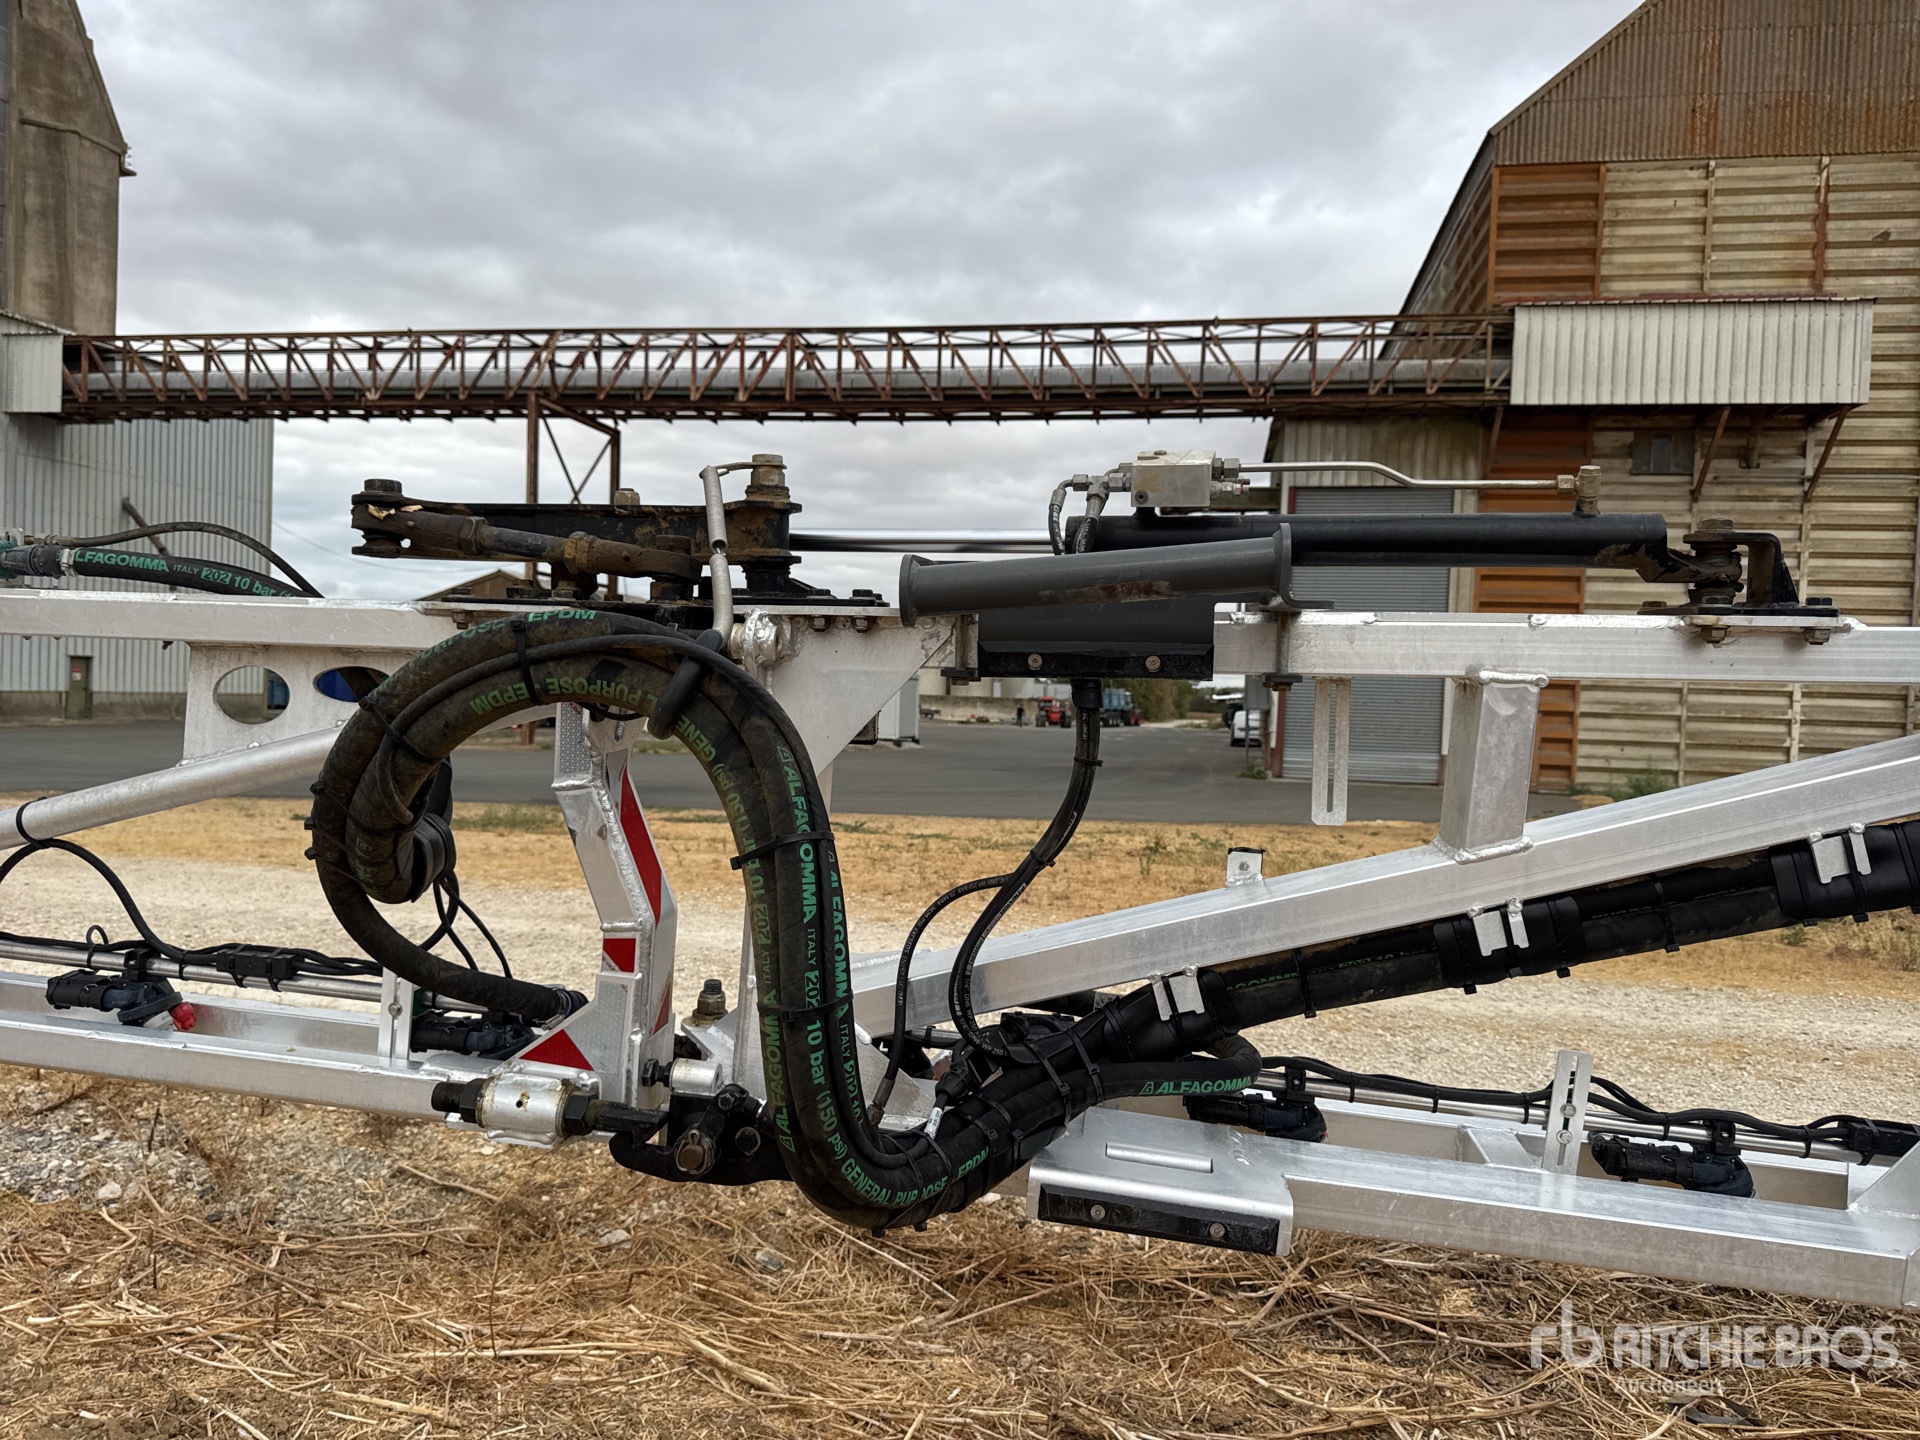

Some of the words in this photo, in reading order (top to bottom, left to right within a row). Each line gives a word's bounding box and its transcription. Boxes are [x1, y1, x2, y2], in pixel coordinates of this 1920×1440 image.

[74, 548, 170, 573] LFAGOMMA
[173, 563, 200, 576] ITALY
[202, 567, 231, 584] 202
[233, 575, 251, 590] 10
[252, 580, 276, 598] bar
[528, 609, 597, 622] EPDM
[469, 681, 530, 716] EPDM
[546, 676, 644, 707] PURPOSE
[749, 875, 766, 898] 10
[753, 903, 772, 944] 202
[807, 928, 817, 966] ITALY
[761, 950, 772, 984] ITALY
[804, 970, 821, 1009] 202
[806, 1019, 823, 1046] 10
[839, 1023, 851, 1058] ITALY
[809, 1049, 826, 1085] bar
[1156, 1076, 1252, 1094] ALFAGOMMA
[816, 1090, 839, 1132] (150
[828, 1130, 849, 1160] psi)
[840, 1157, 892, 1206] GENERAL
